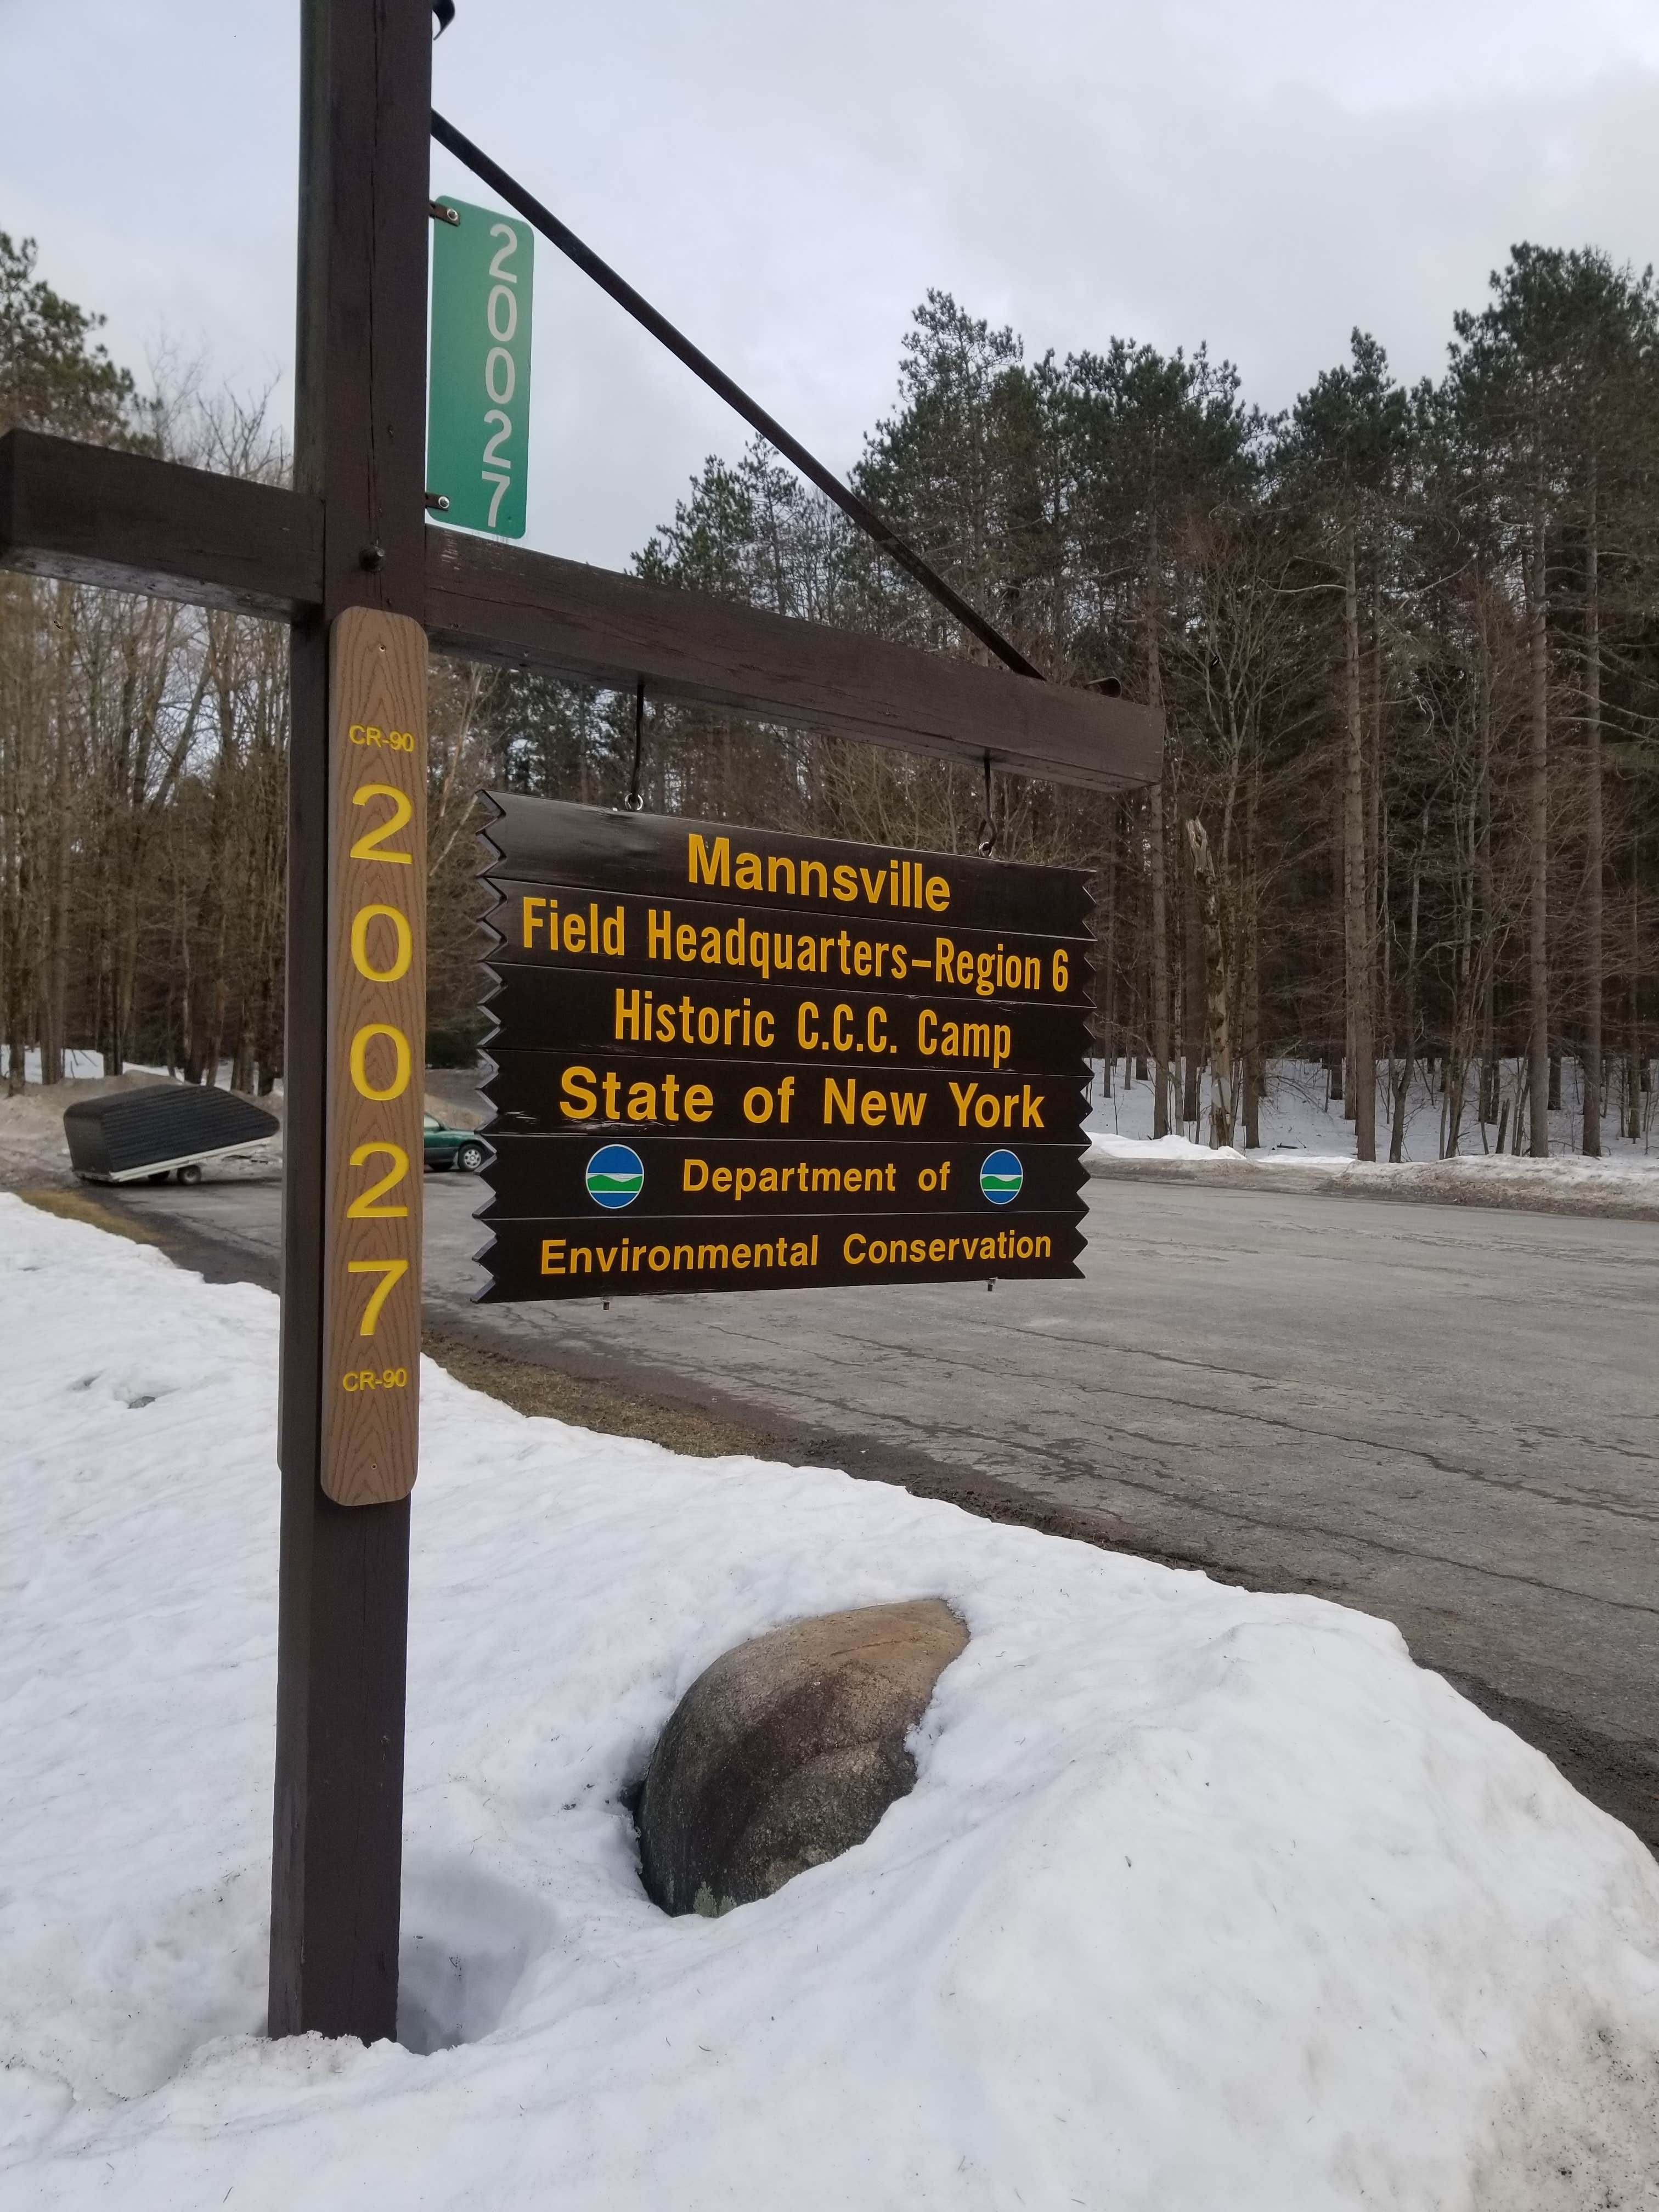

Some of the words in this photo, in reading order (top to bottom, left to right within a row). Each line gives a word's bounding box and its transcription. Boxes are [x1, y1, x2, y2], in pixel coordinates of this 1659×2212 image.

[482, 223, 517, 527] 20027
[349, 723, 415, 752] CR-90
[689, 833, 950, 911] Mannsville
[523, 897, 624, 955] Field
[1053, 949, 1068, 992] 6
[346, 783, 413, 1334] 20027
[616, 989, 774, 1047] Historic
[798, 1002, 896, 1052] C.C.C.
[919, 1009, 1010, 1068] Camp
[560, 1066, 713, 1122] State
[743, 1076, 794, 1123] of
[824, 1078, 927, 1126] New
[949, 1082, 1044, 1127] York
[684, 1159, 896, 1200] Department
[918, 1161, 950, 1191] of
[541, 1235, 818, 1274] Environmental
[844, 1231, 1051, 1264] Conservation
[342, 1368, 408, 1391] CR-90
